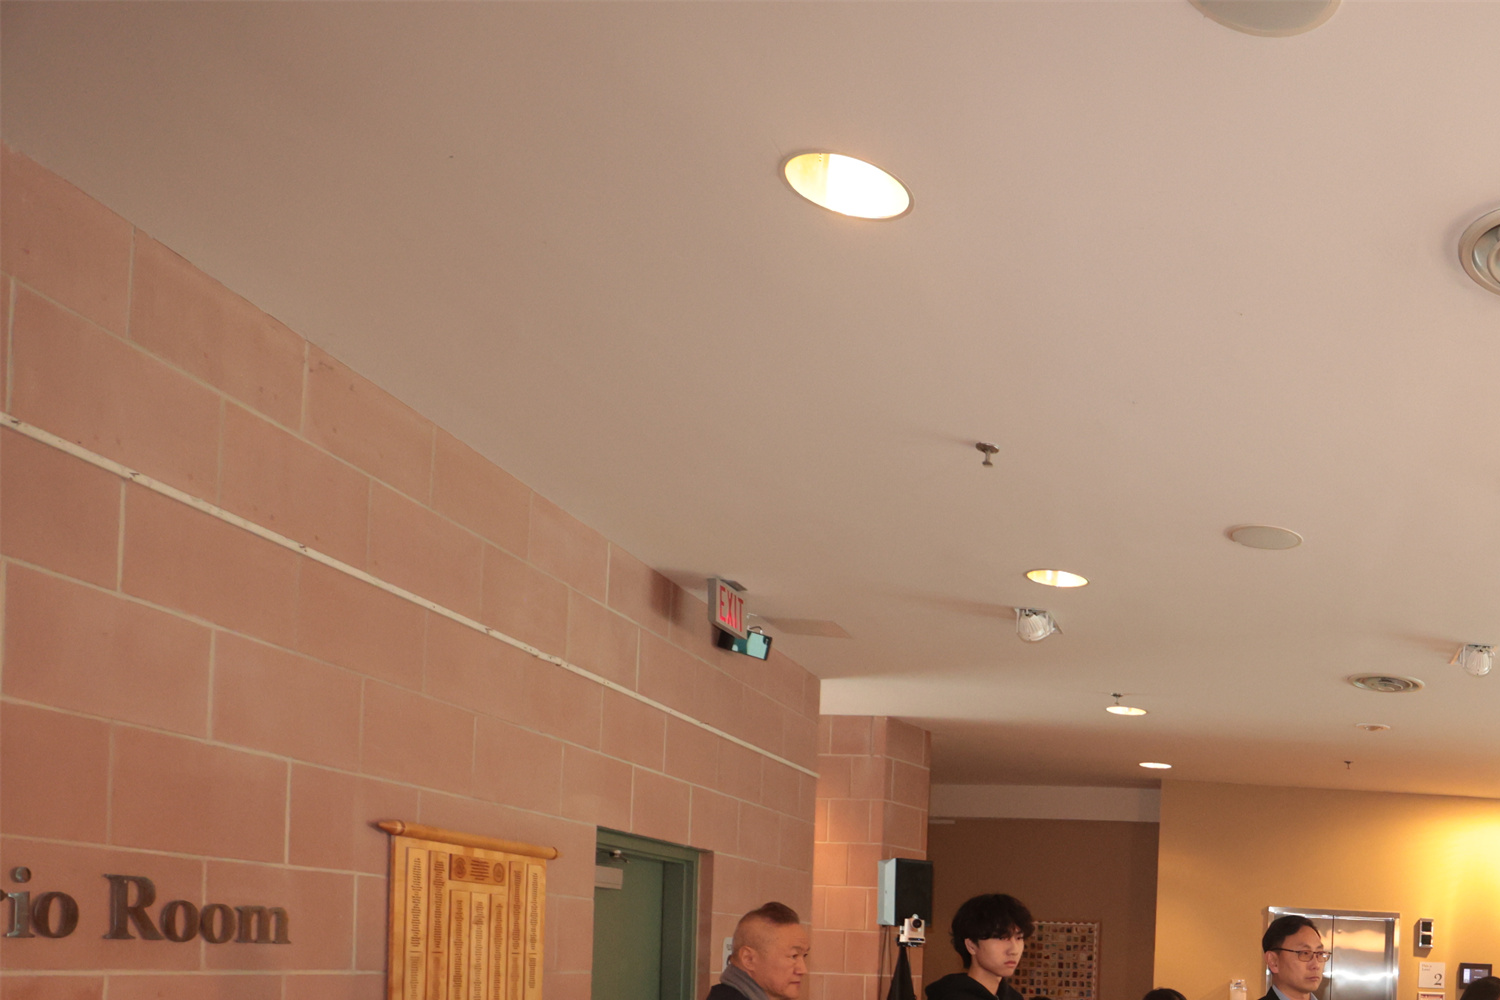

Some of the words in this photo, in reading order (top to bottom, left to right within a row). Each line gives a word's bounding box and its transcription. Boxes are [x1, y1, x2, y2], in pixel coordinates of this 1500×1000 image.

[719, 585, 744, 633] EXIT
[0, 866, 79, 938] io
[101, 873, 292, 945] Room
[1433, 973, 1443, 986] 2
